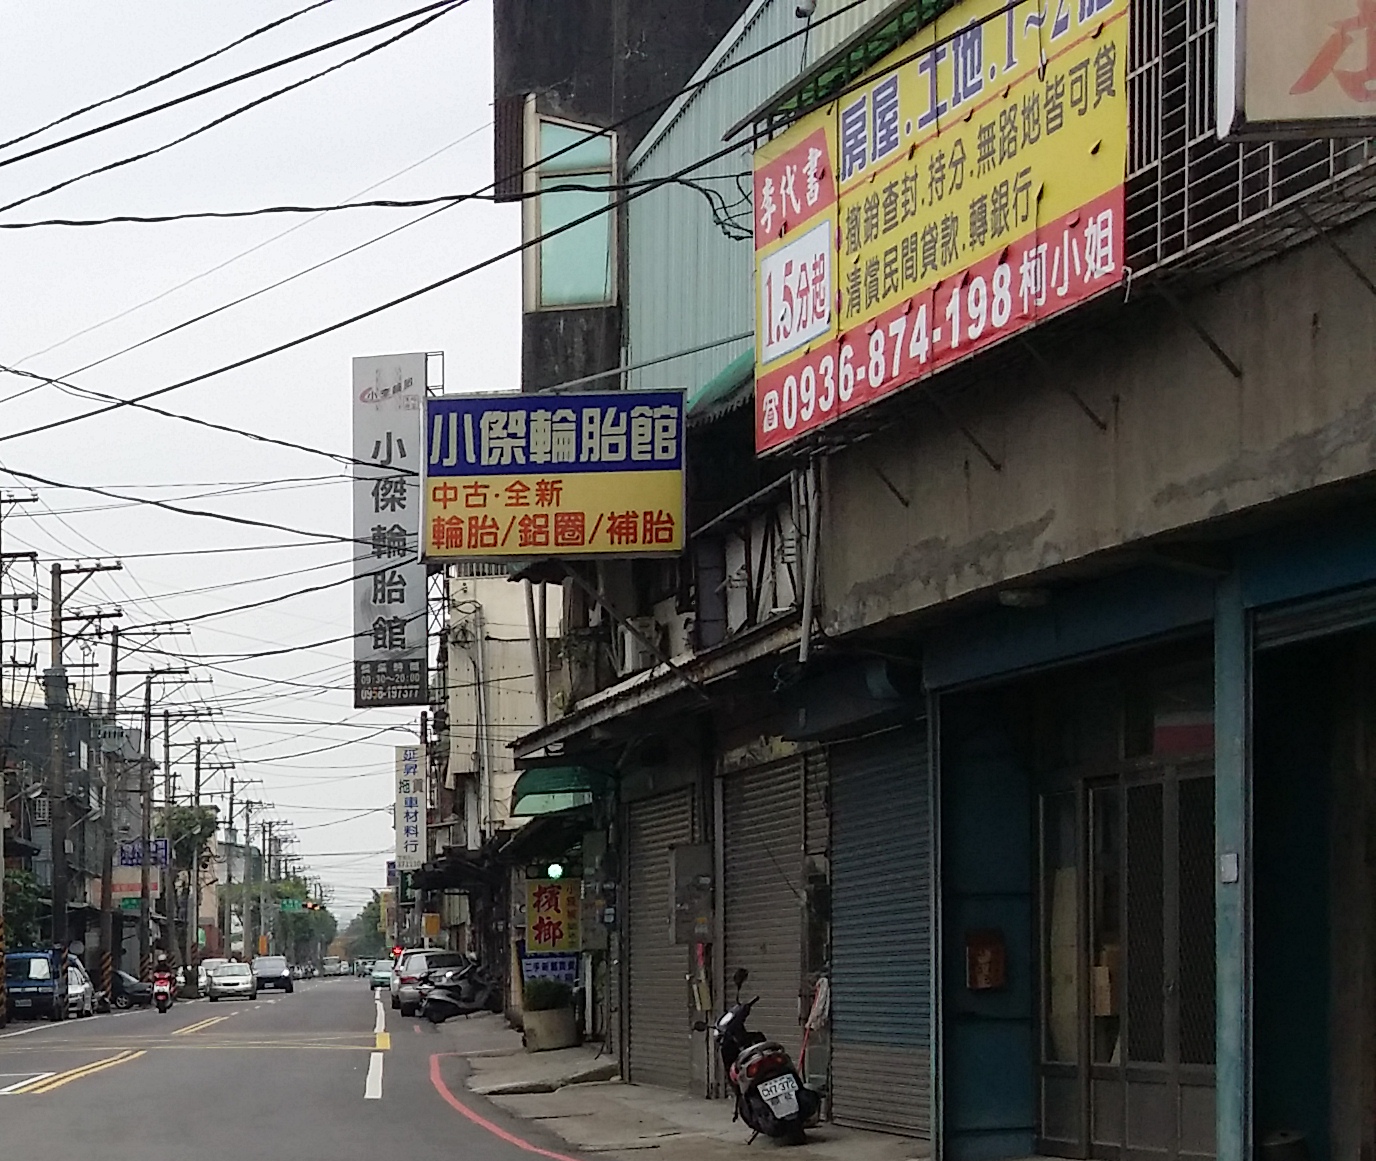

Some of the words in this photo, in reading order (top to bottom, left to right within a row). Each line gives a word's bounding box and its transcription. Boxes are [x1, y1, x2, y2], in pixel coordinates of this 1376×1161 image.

[430, 405, 679, 468] 小傑輪胎館
[371, 431, 408, 651] 小傑輪胎館
